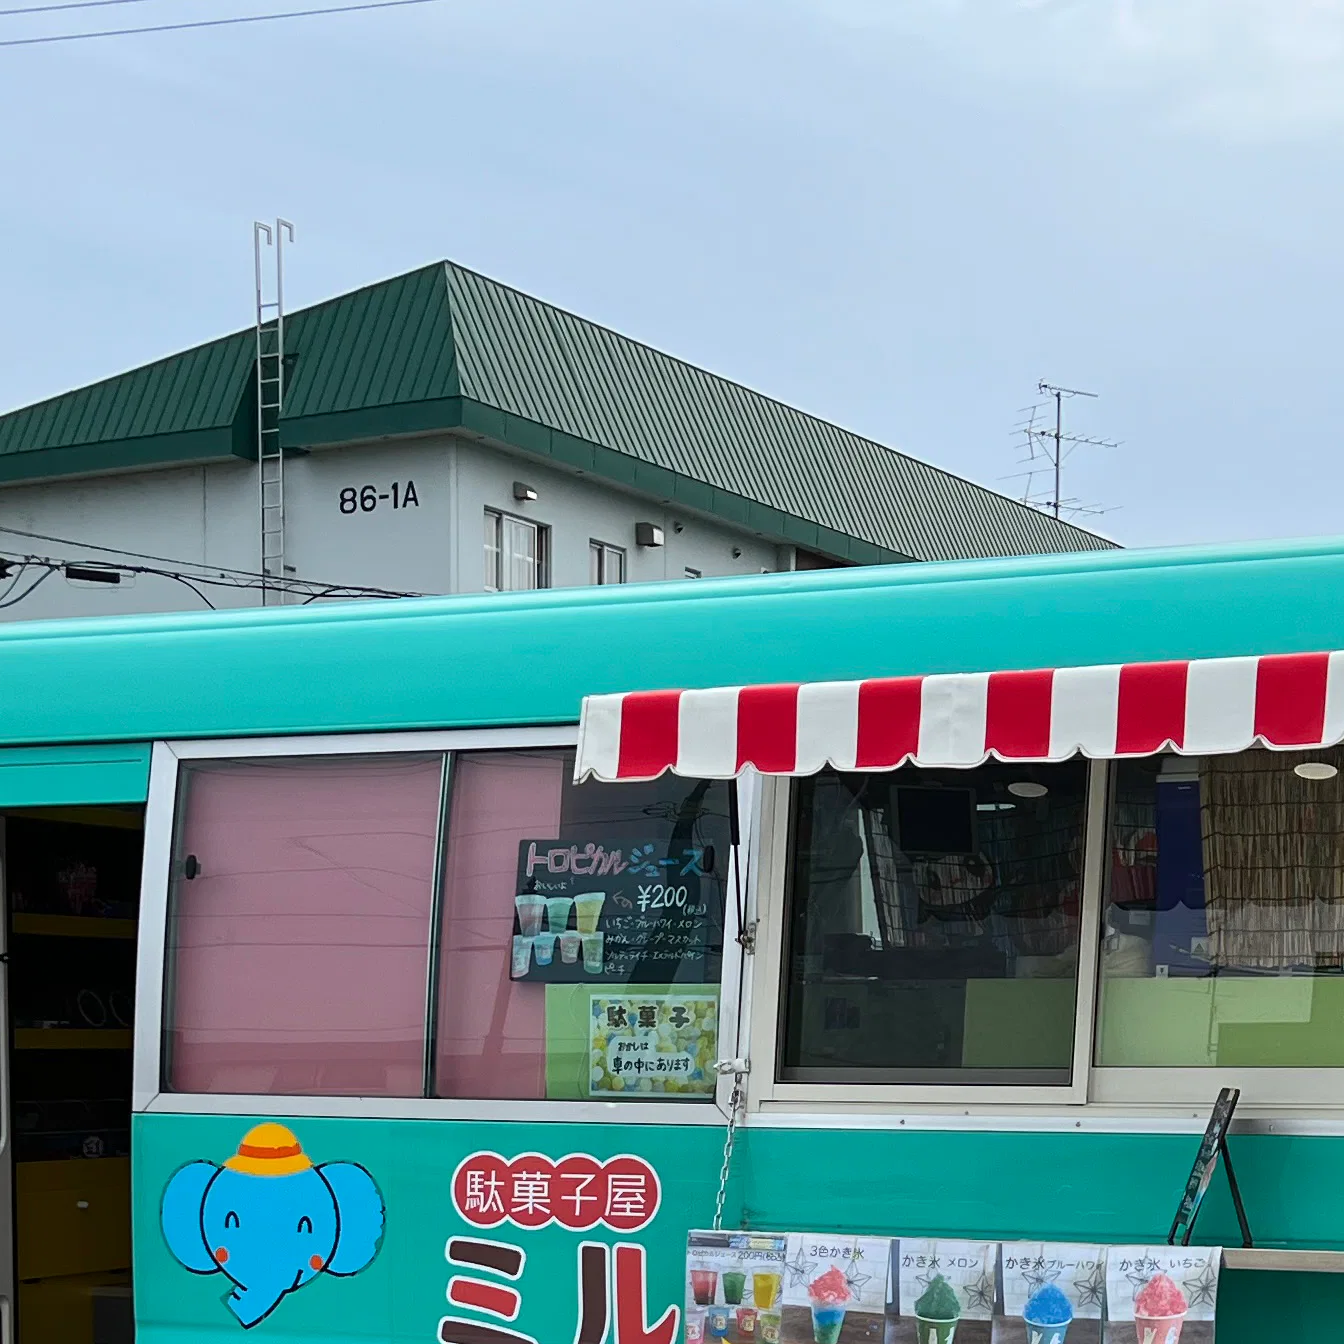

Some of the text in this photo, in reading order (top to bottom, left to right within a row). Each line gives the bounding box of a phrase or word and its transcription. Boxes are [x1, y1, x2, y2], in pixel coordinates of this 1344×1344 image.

[339, 480, 420, 514] 86-1A
[526, 842, 705, 878] トロピカルジュース
[636, 884, 688, 912] ¥200
[606, 1005, 691, 1029] 駄菓子
[617, 1041, 650, 1052] おかしは
[611, 1055, 691, 1075] 車の中にあります
[464, 1169, 647, 1217] 駄菓子屋
[809, 1245, 865, 1260] 3色かき氷
[901, 1254, 979, 1269] かき氷 メロン
[1005, 1255, 1046, 1271] かき氷
[1119, 1257, 1207, 1273] かき氷 いちご
